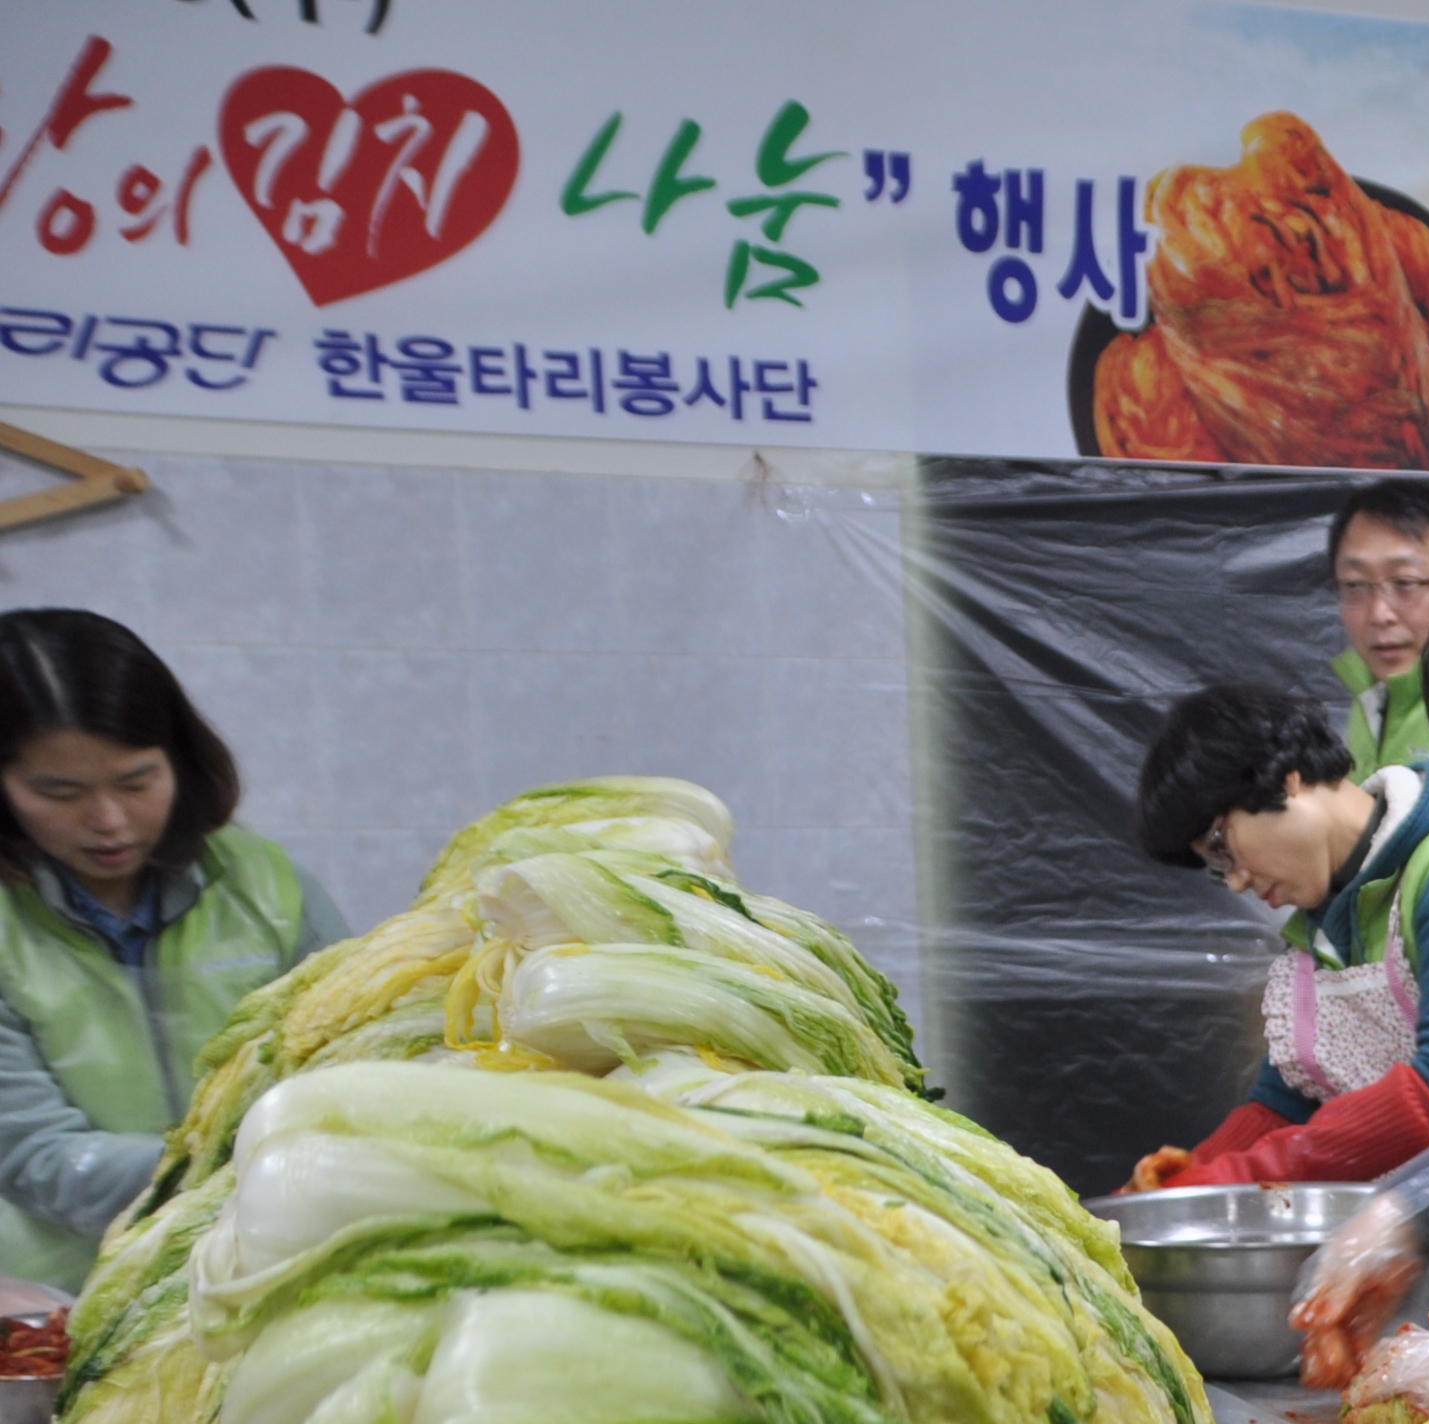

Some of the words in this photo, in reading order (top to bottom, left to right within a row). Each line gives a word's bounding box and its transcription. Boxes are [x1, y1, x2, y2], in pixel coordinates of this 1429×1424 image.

[244, 95, 489, 259] 김치
[951, 157, 1148, 323] 행사
[314, 329, 819, 423] 한울타리봉사단
